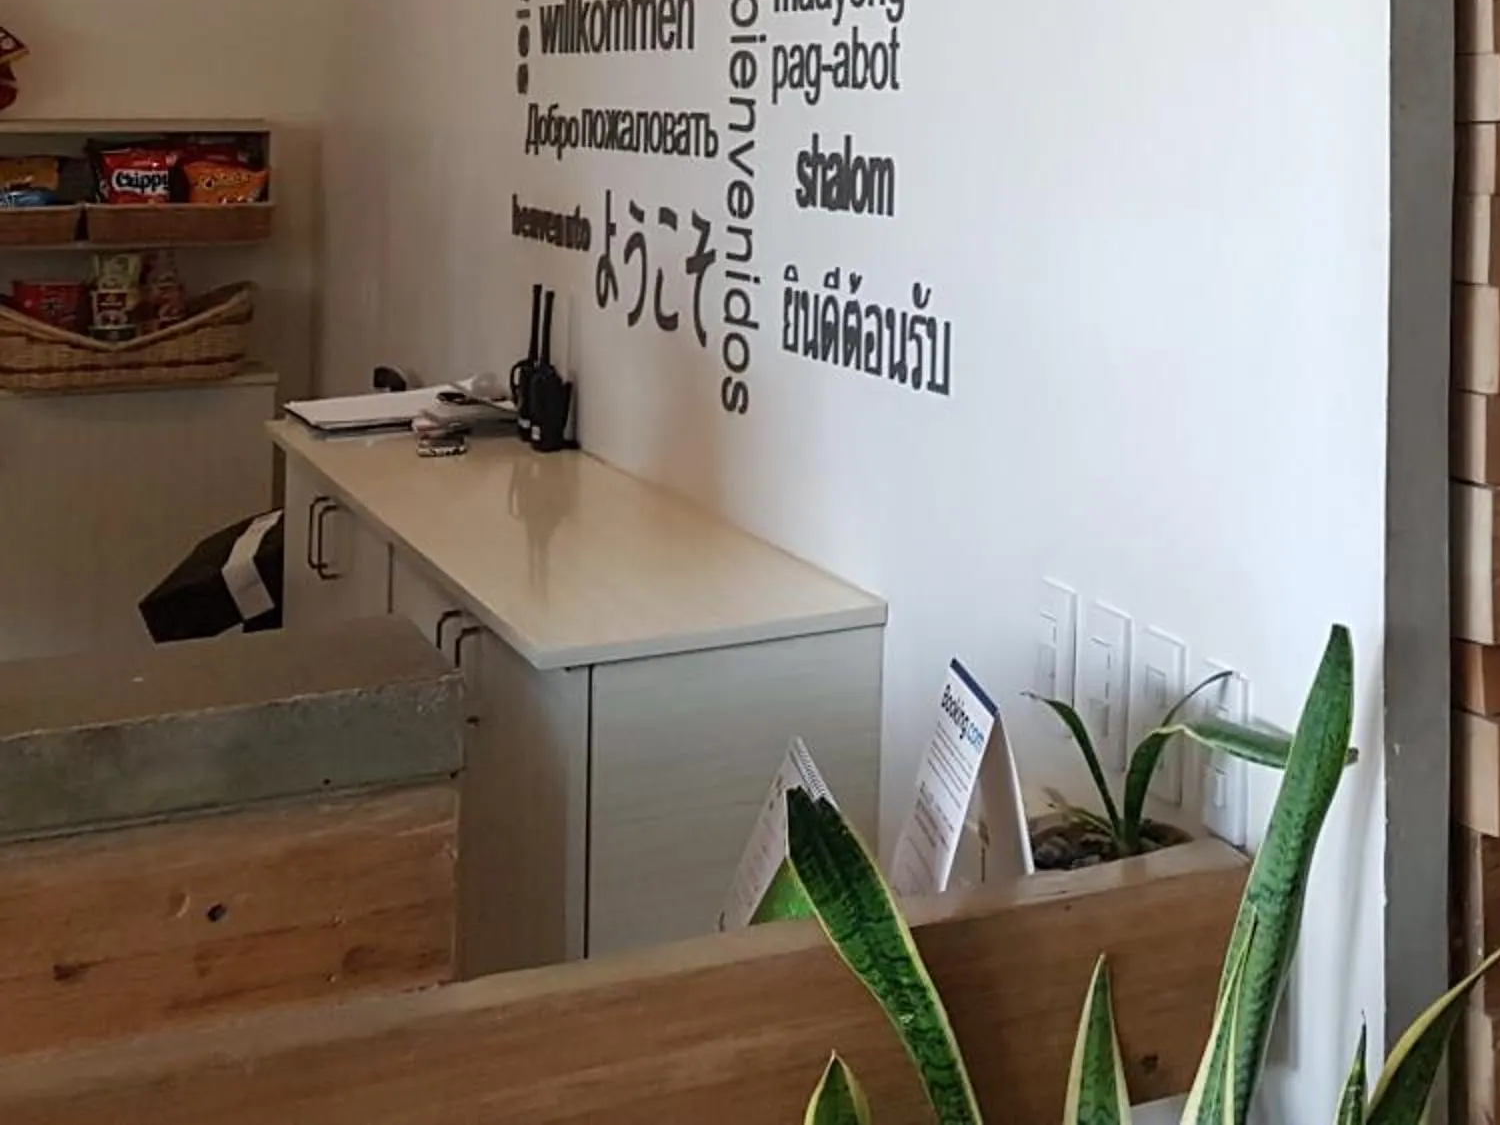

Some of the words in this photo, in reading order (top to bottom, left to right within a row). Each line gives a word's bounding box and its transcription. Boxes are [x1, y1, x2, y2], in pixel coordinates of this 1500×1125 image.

[772, 26, 900, 106] pag-abot
[525, 103, 579, 160] Добро
[581, 109, 719, 158] пожаловать
[796, 133, 895, 216] shalom
[596, 189, 716, 347] ようこそ
[782, 264, 951, 396] ยินดีต้อนรับ
